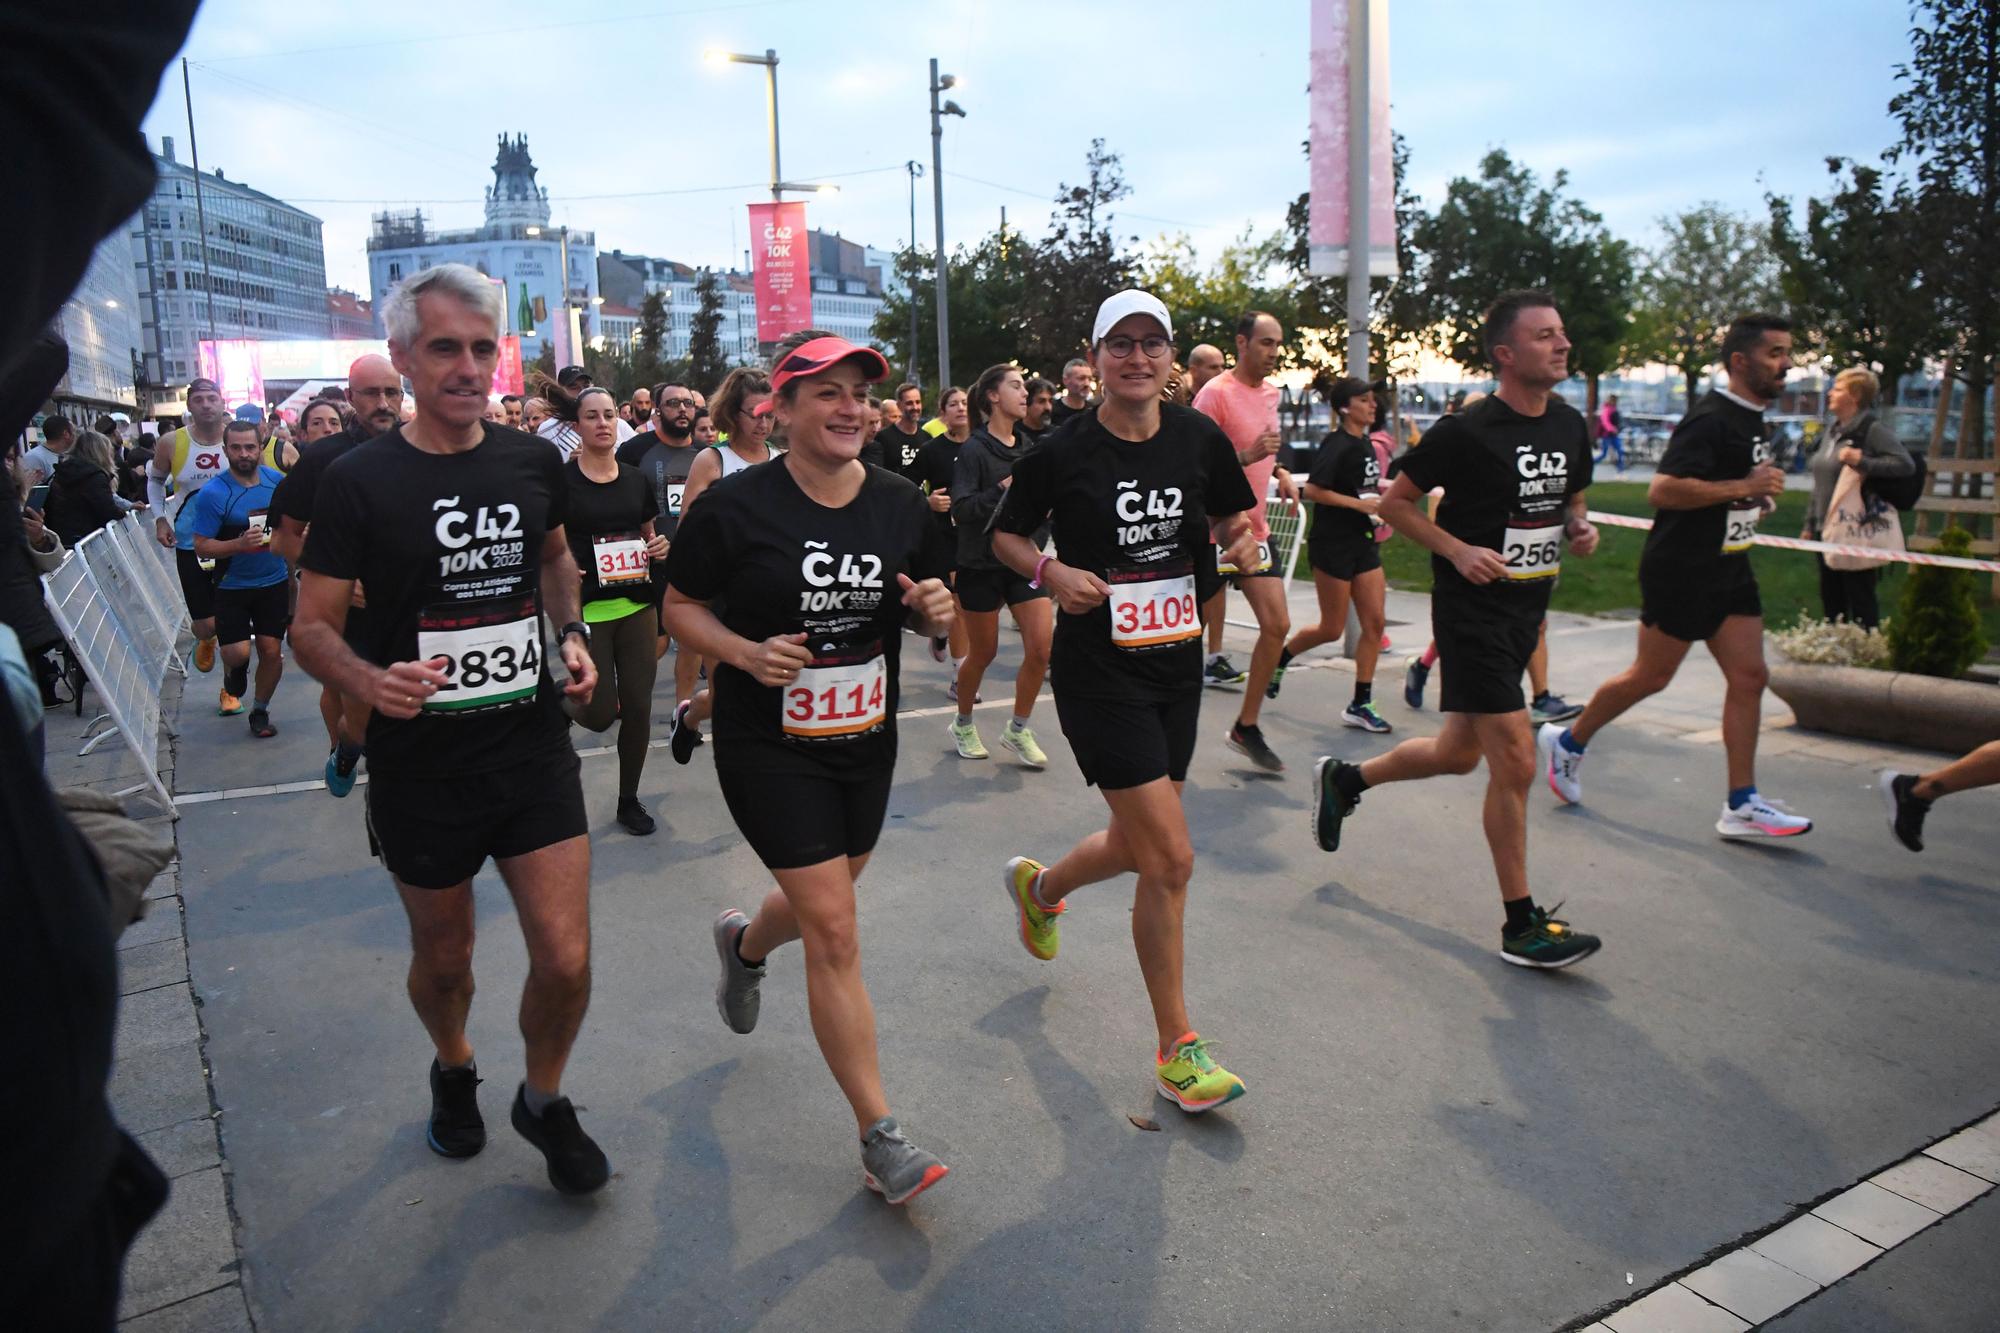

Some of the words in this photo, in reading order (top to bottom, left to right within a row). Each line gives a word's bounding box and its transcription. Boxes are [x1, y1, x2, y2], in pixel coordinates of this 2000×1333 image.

[767, 245, 791, 258] 10K
[1519, 479, 1545, 497] 10K
[1117, 524, 1158, 546] 10K
[440, 547, 490, 577] 10K
[491, 542, 524, 556] 02.10
[492, 554, 523, 568] 2022
[600, 550, 649, 573] 3119
[1504, 541, 1560, 567] 256
[443, 583, 469, 591] Corre
[800, 591, 850, 612] 10K
[1116, 594, 1194, 634] 3109
[429, 639, 539, 690] 2834
[786, 676, 883, 721] 3114
